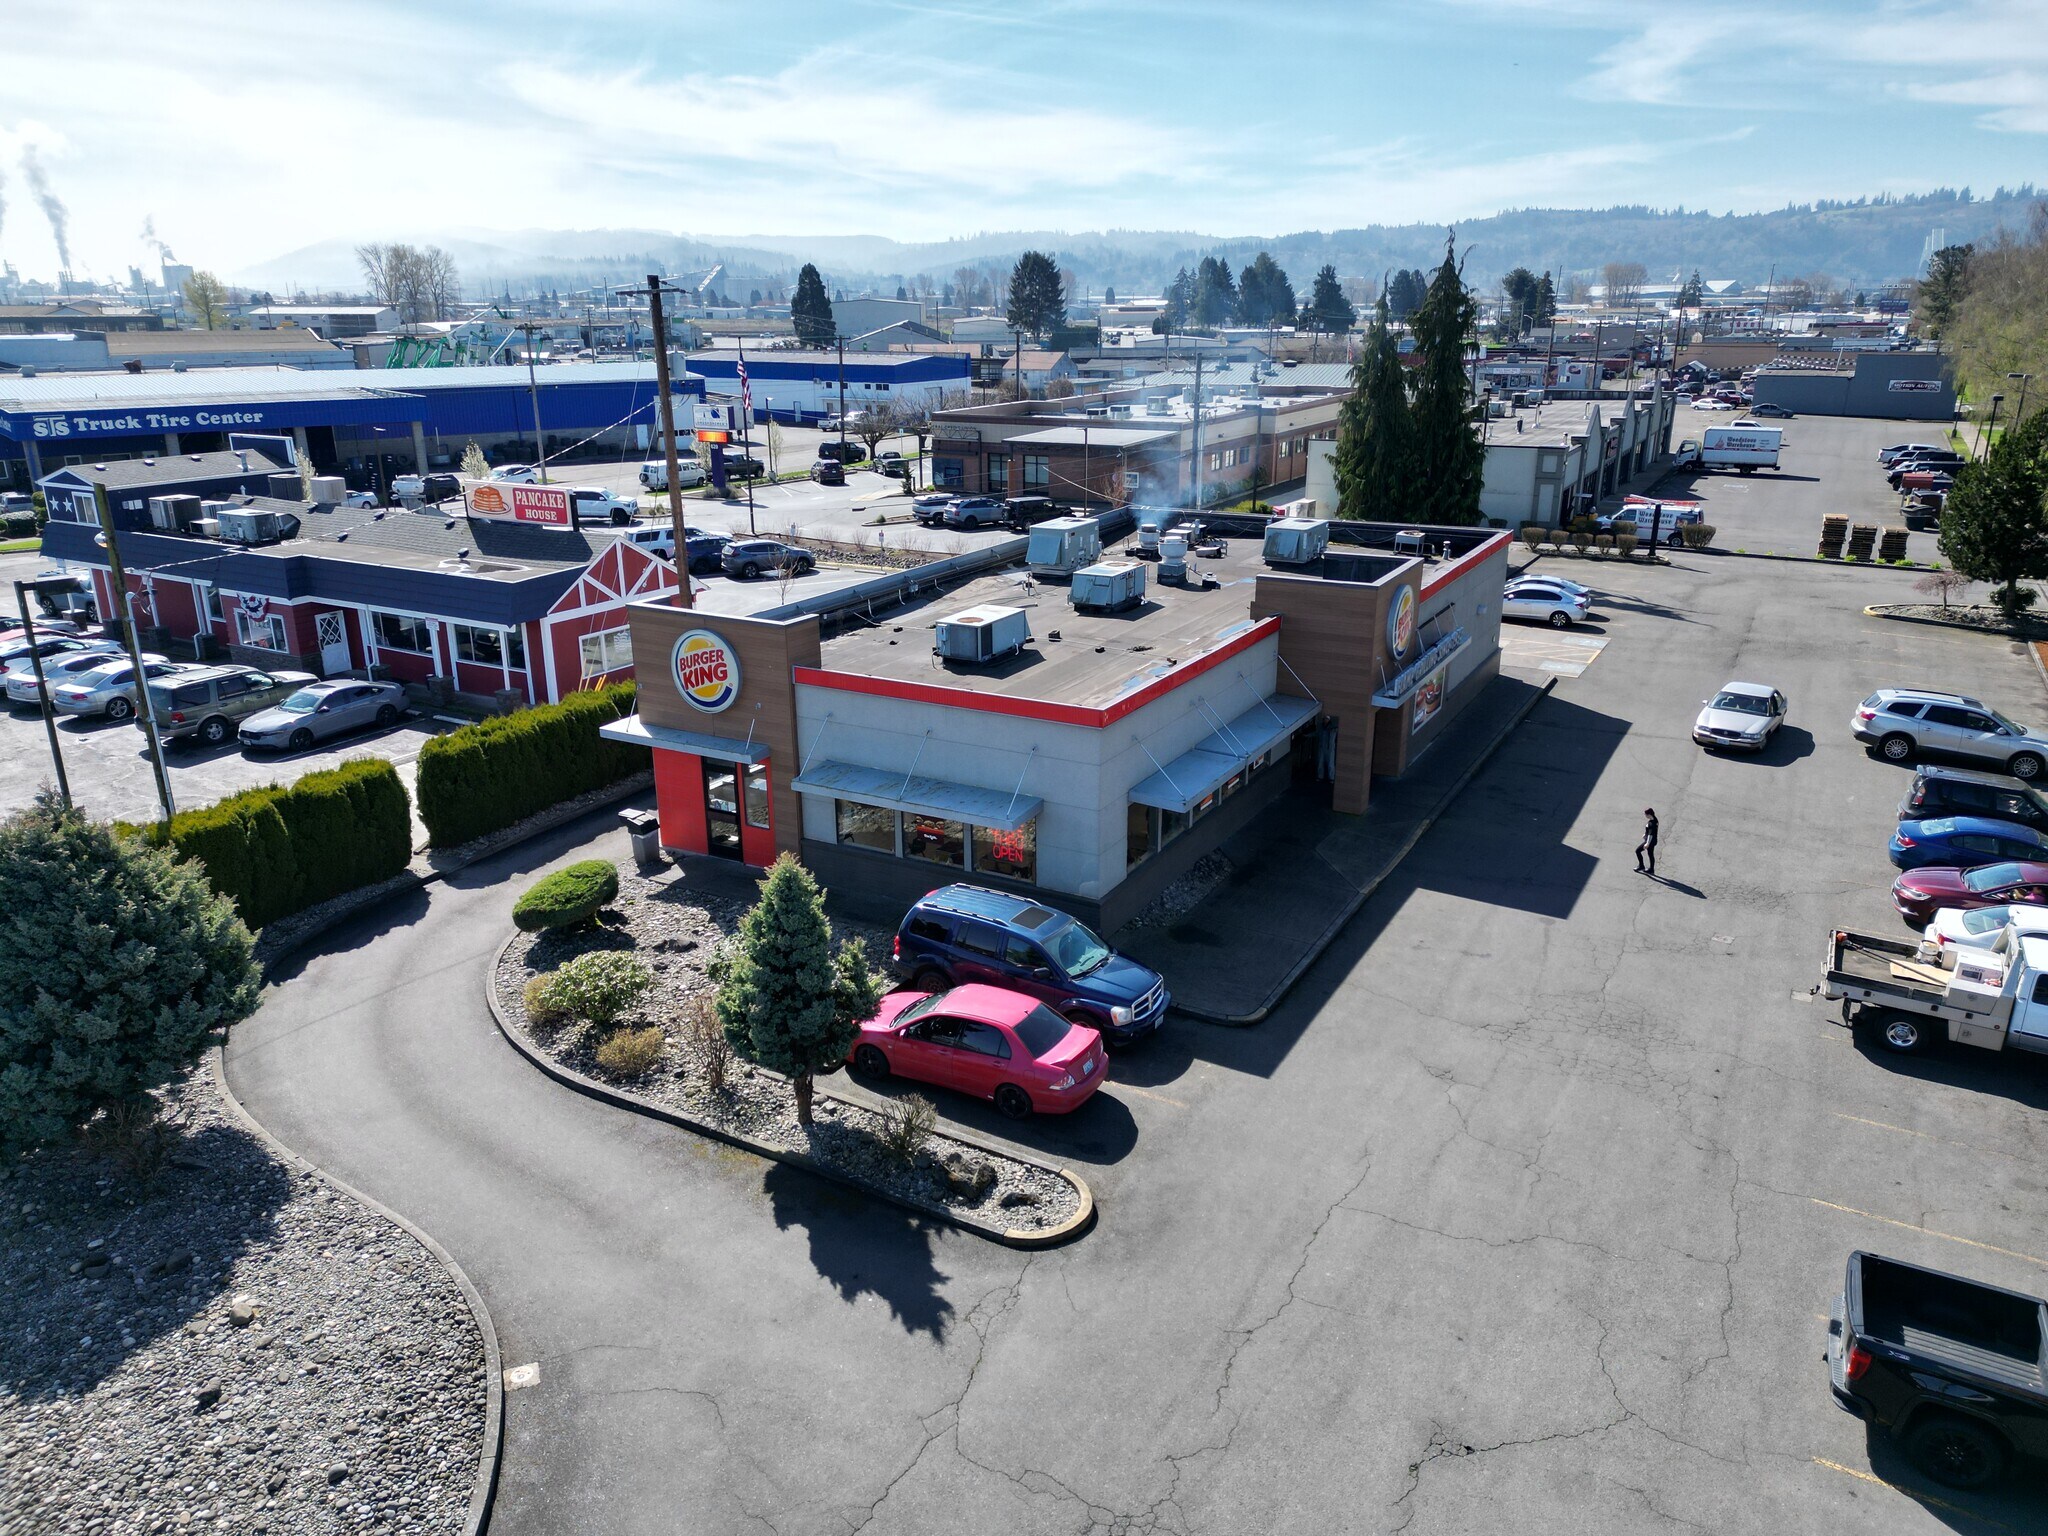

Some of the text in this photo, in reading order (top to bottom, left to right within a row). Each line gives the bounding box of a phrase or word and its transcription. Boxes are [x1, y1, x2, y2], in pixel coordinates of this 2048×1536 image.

[73, 416, 142, 432] Truck
[146, 413, 191, 428] Tire
[196, 411, 263, 425] Center
[514, 490, 565, 509] PANCAKE
[525, 509, 558, 521] HOUSE
[679, 649, 725, 673] BURGER
[682, 662, 729, 691] KING
[992, 844, 1024, 862] OPEN
